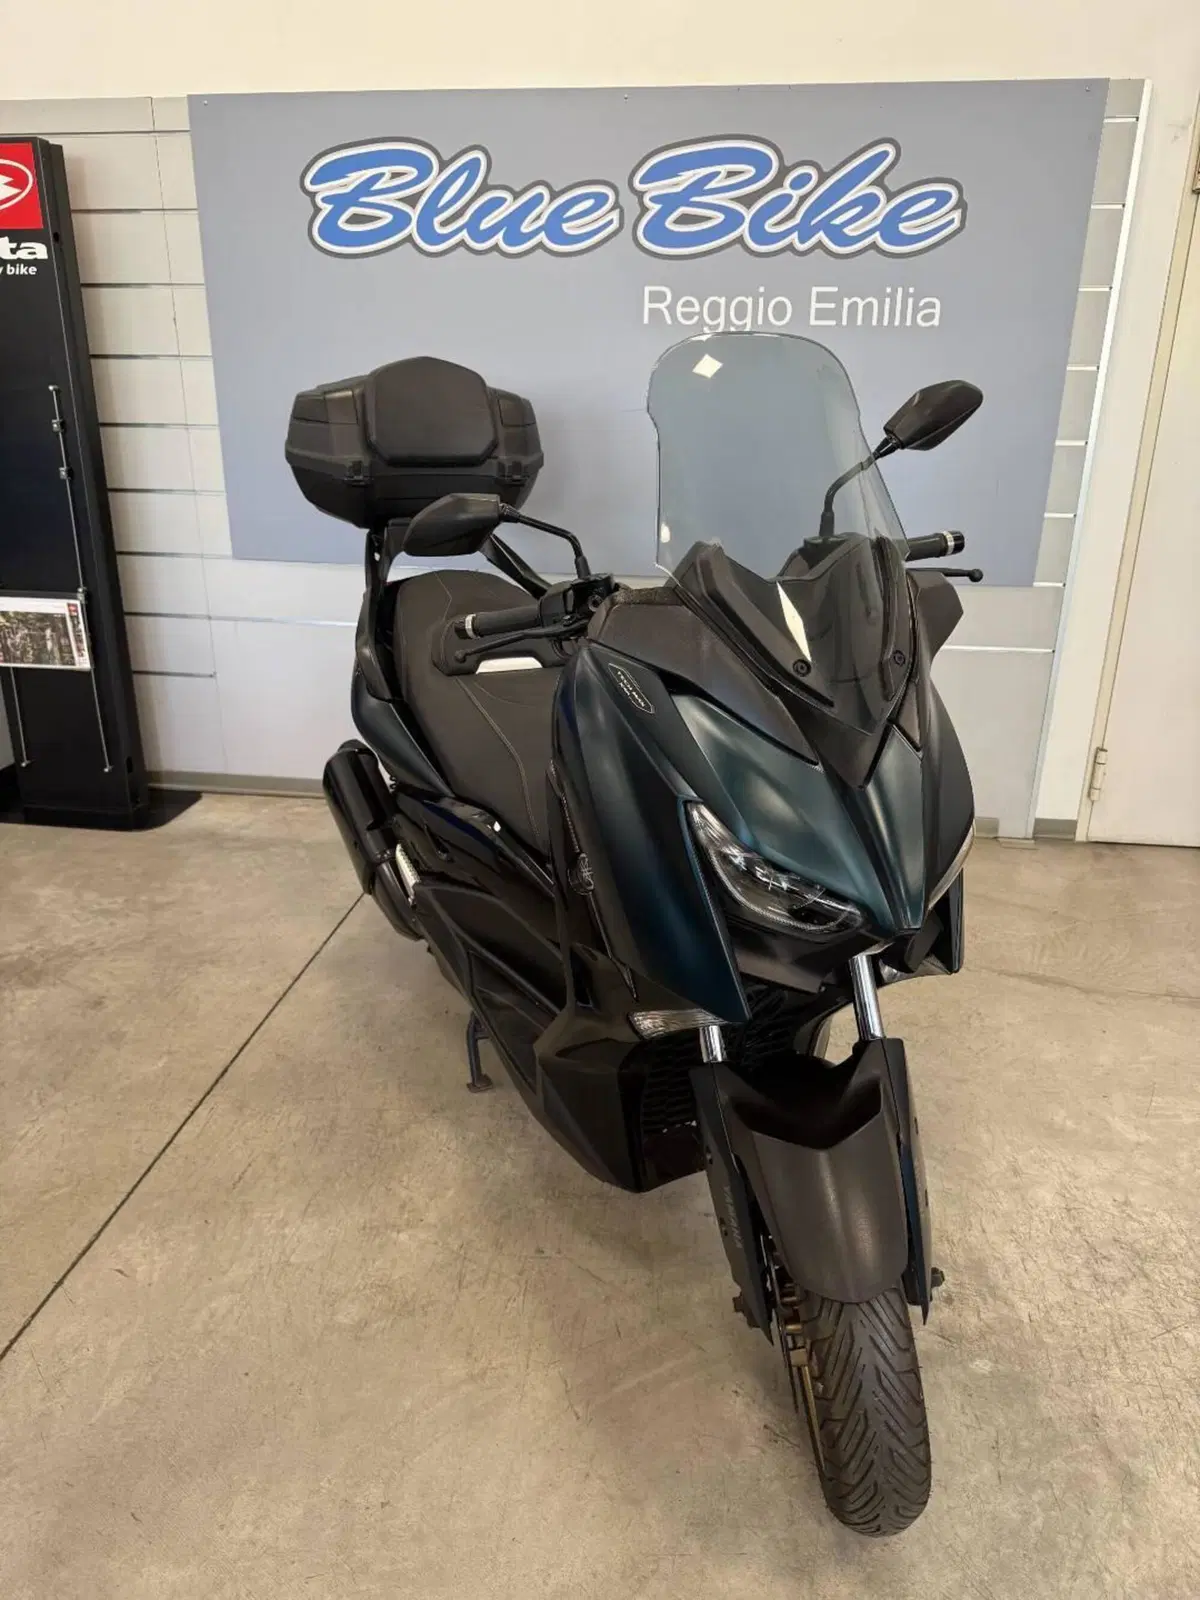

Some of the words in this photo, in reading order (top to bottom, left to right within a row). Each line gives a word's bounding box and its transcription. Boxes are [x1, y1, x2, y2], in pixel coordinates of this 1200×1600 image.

[300, 136, 623, 258] Blue
[627, 134, 966, 260] Bike
[6, 263, 38, 275] bike
[642, 285, 793, 332] Reggio
[809, 286, 942, 327] Emilia
